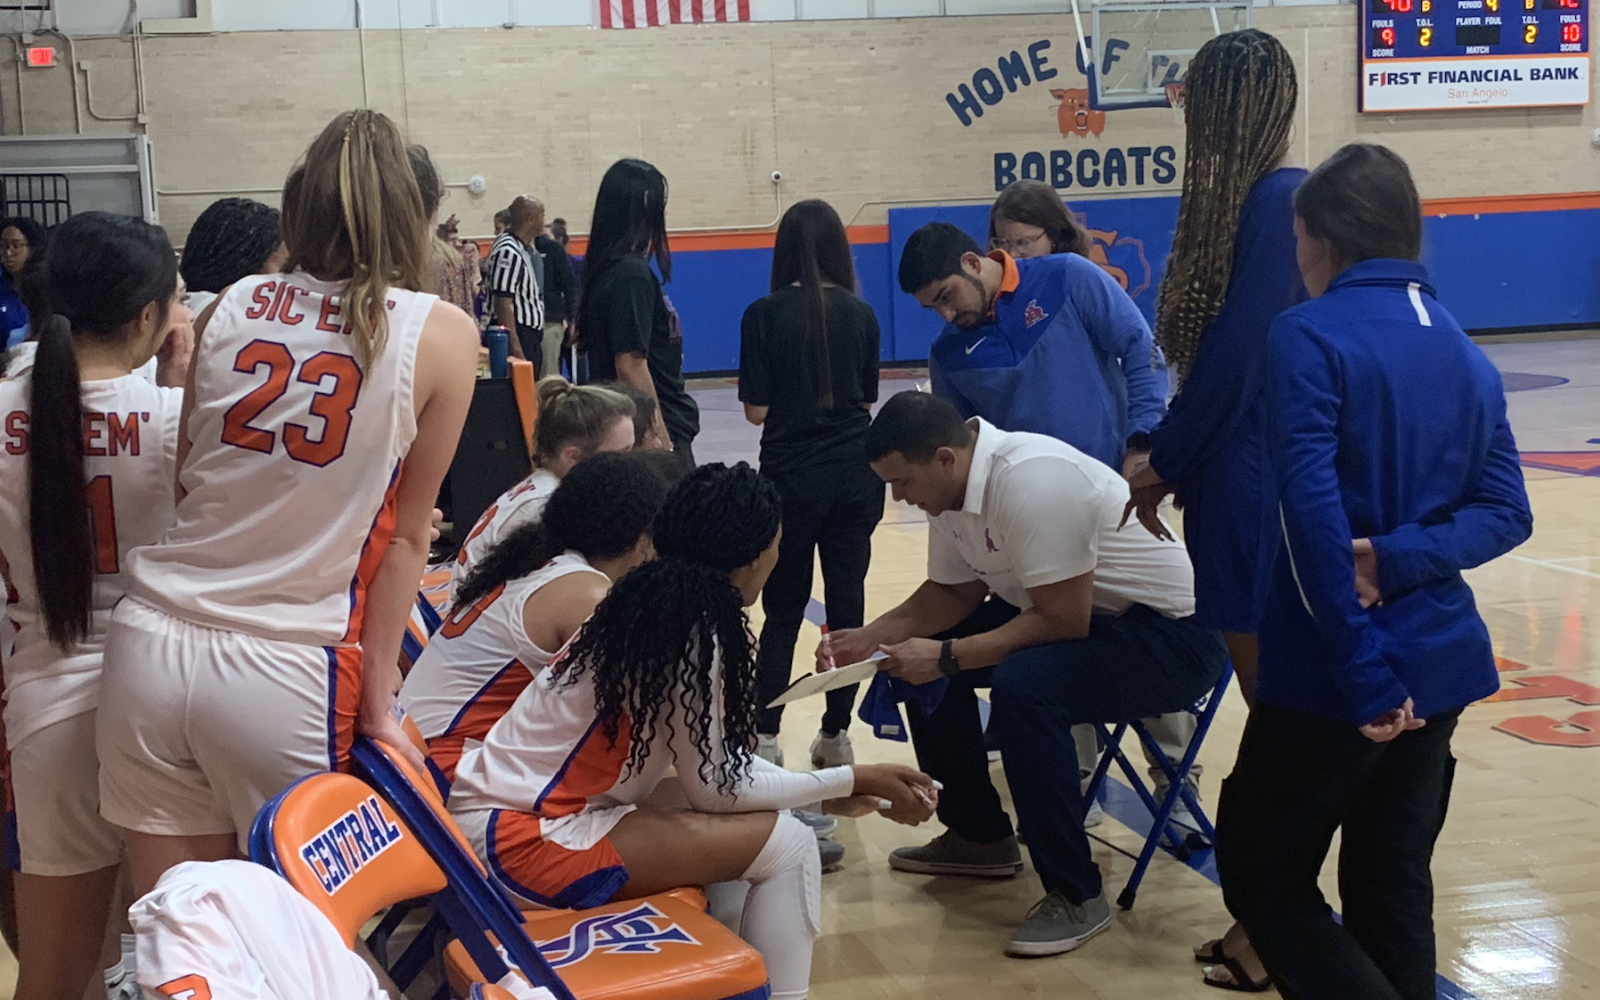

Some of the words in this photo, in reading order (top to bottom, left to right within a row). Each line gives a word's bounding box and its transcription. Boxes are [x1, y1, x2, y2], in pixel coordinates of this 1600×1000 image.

[1458, 1, 1482, 9] PERIOD
[1372, 19, 1394, 28] FOULS
[1416, 19, 1434, 27] T.O.L.
[1456, 17, 1481, 25] PLAYER
[1485, 16, 1502, 25] FOUL
[1522, 16, 1539, 24] T.O.L.
[1560, 15, 1581, 23] FOULS
[1381, 28, 1394, 46] 9
[1420, 28, 1432, 46] 2
[1525, 25, 1537, 43] 2
[1563, 24, 1580, 42] 10
[1372, 48, 1394, 57] SCORE
[1466, 46, 1489, 54] MATCH
[946, 40, 1057, 127] HOME
[1369, 71, 1421, 87] FIRST
[1428, 69, 1523, 84] FINANCIAL
[1530, 67, 1579, 81] BANK
[1447, 88, 1468, 99] San
[1472, 87, 1508, 100] Angelo
[994, 146, 1177, 192] BOBCATS
[246, 281, 304, 325] SIC
[221, 339, 363, 467] 23
[299, 795, 404, 897] CENTRAL
